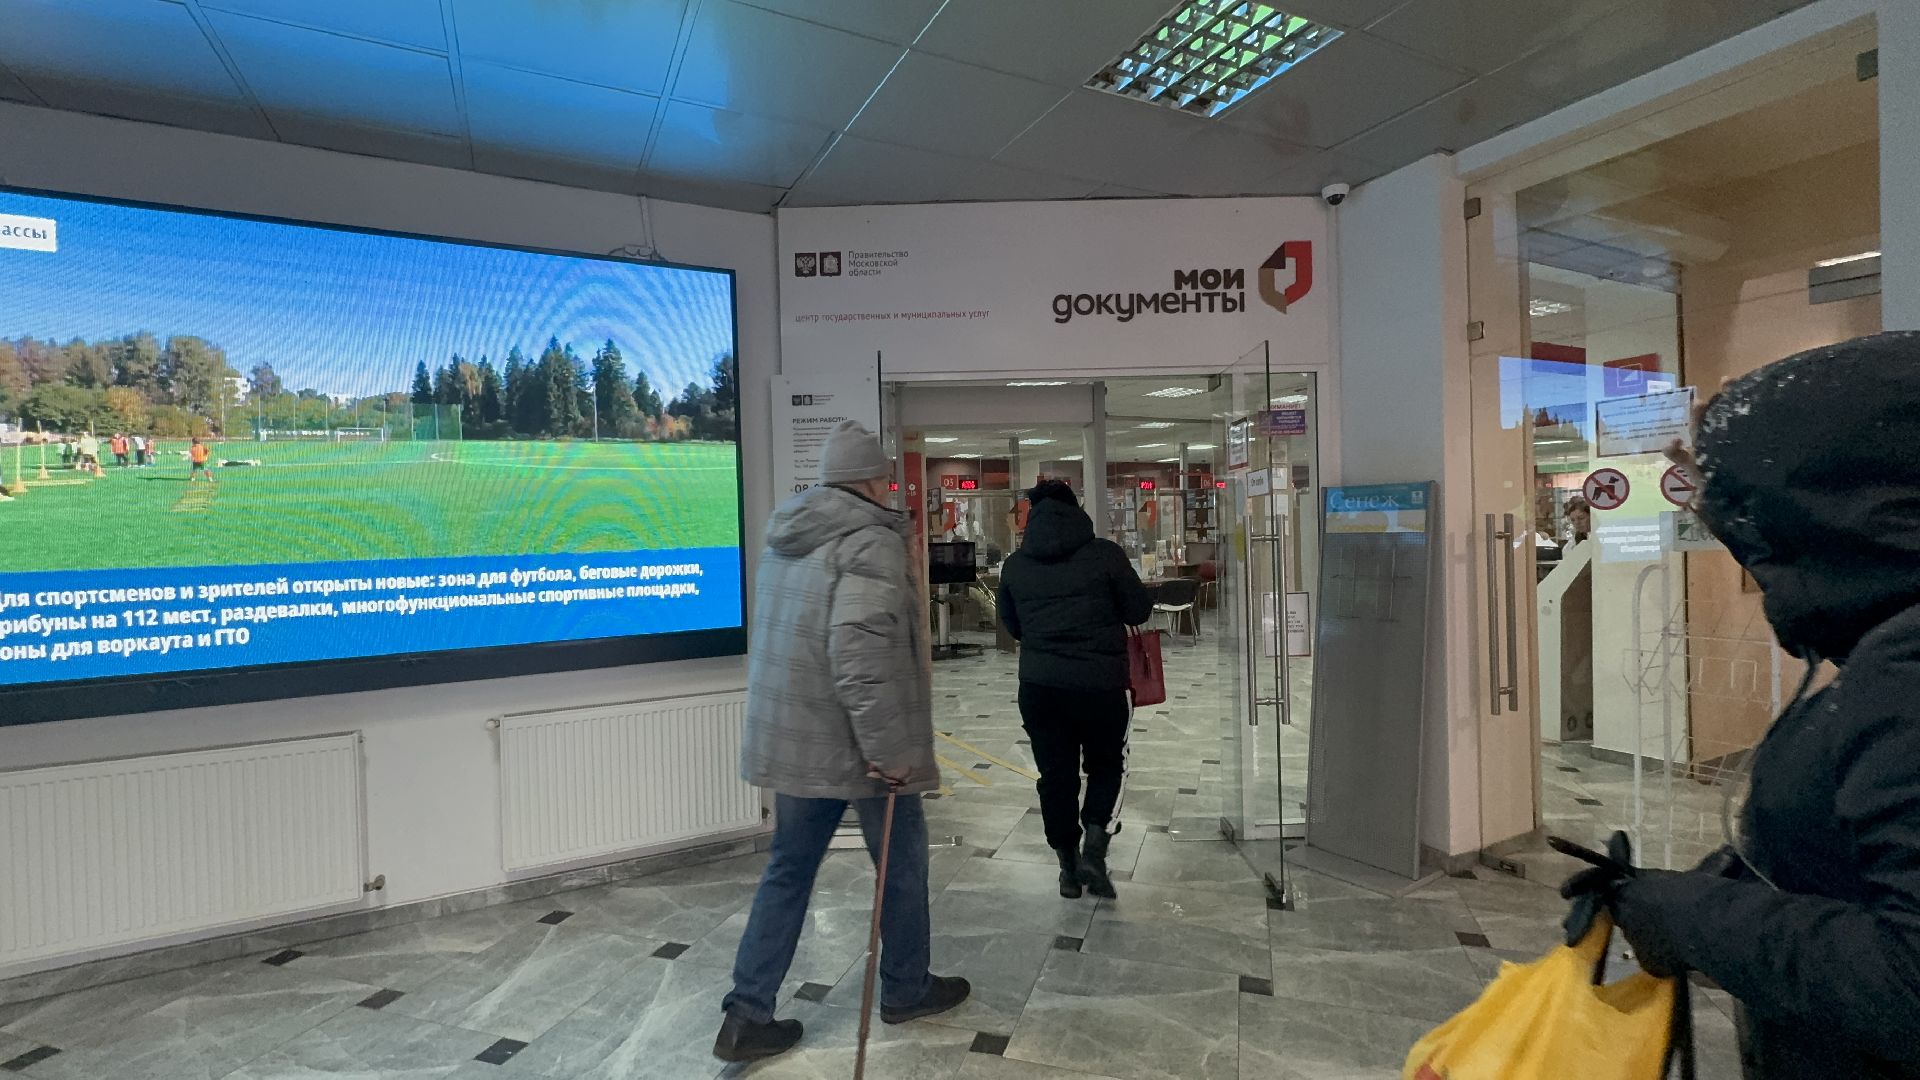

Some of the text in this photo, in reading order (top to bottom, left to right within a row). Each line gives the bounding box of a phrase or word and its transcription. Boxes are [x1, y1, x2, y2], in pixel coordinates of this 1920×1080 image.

[1, 225, 48, 239] ассы
[848, 251, 909, 260] Правительство
[848, 259, 898, 268] Московской
[848, 268, 882, 277] области
[1174, 269, 1245, 290] мои
[795, 313, 819, 323] центр
[821, 312, 891, 323] государственных
[901, 311, 967, 321] муниципальных
[968, 309, 990, 319] услуг
[1052, 292, 1245, 324] документы
[1330, 491, 1400, 510] Сенеж
[35, 586, 176, 610] спортсменов
[180, 586, 193, 600] и
[198, 578, 288, 603] зрителей
[292, 578, 372, 596] открыты
[375, 575, 436, 589] новые:
[438, 573, 475, 587] зона
[476, 571, 507, 588] для
[510, 567, 577, 587] футбола,
[579, 564, 637, 580] беговые
[640, 563, 704, 581] дорожки,
[0, 582, 700, 640] рибуны на 112 мест, раздевалки, многофункциональные спортивные площадки,
[0, 627, 251, 661] оны для воркаута и ГТО
